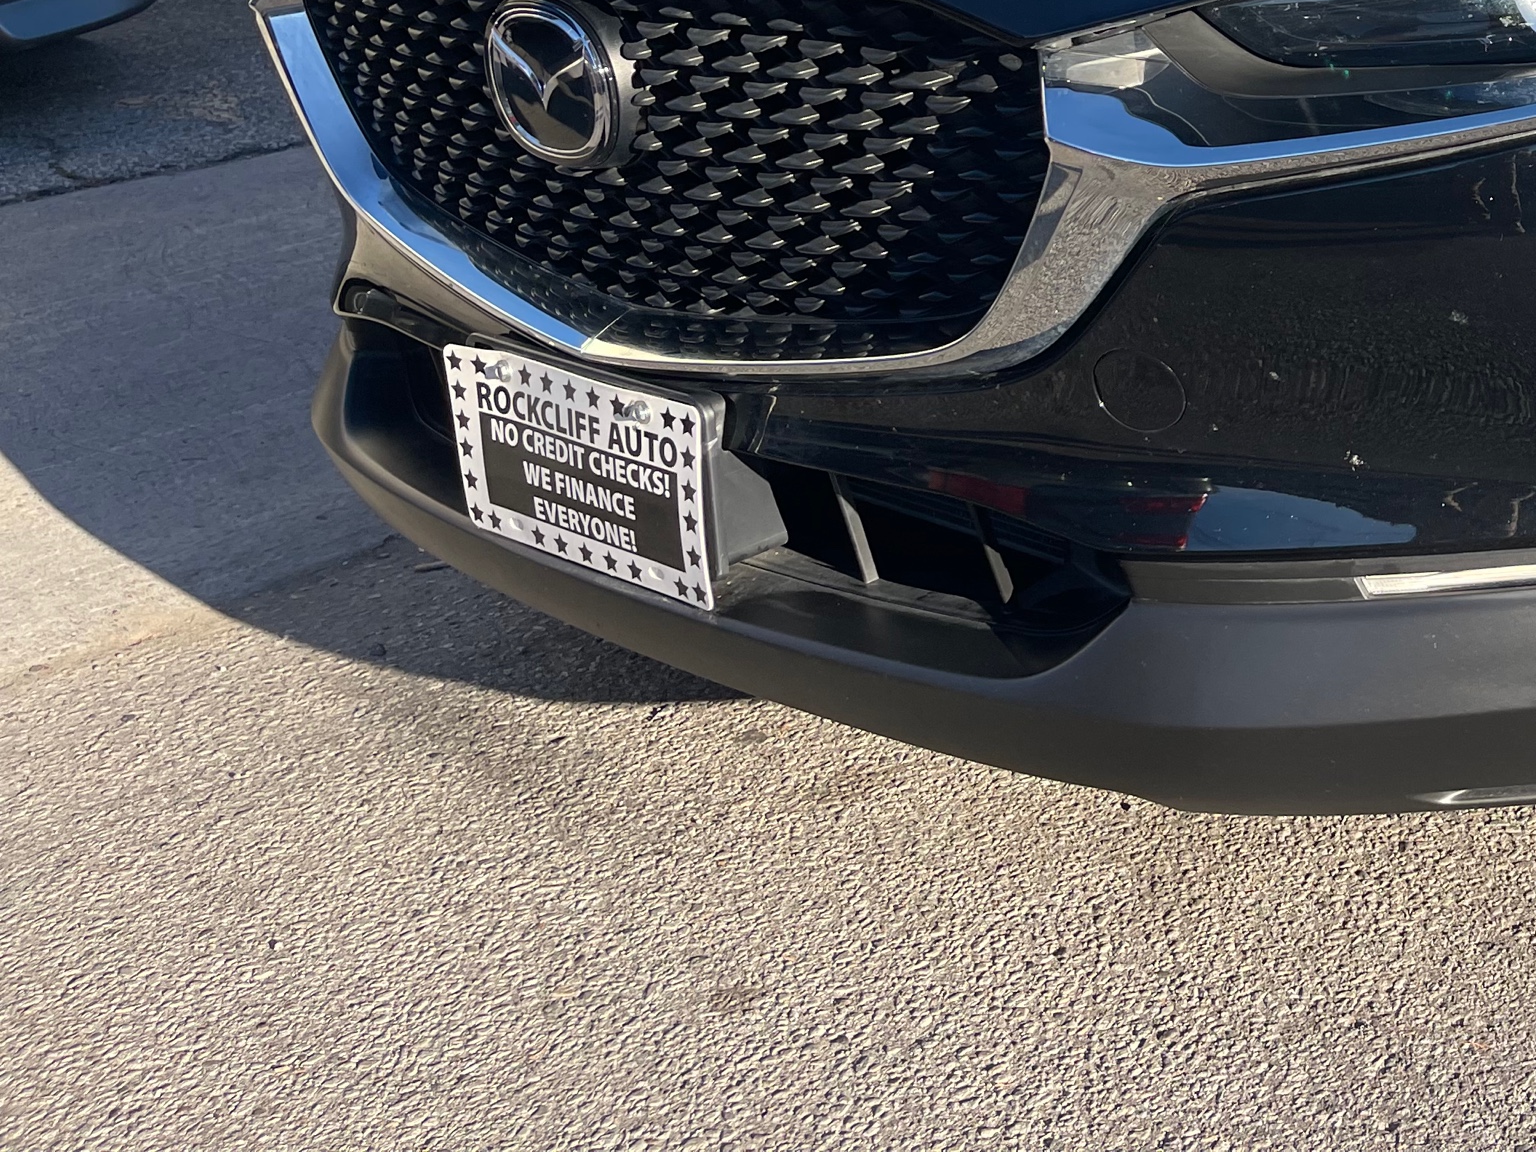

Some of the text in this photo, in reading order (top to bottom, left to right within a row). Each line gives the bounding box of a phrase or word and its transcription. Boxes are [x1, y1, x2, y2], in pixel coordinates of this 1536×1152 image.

[475, 381, 679, 468] ROCKCLIFF AUTO
[490, 418, 671, 499] NO CREDIT CHECKS!
[523, 460, 637, 521] WE FINANCE
[532, 496, 639, 553] EVERYONE!
